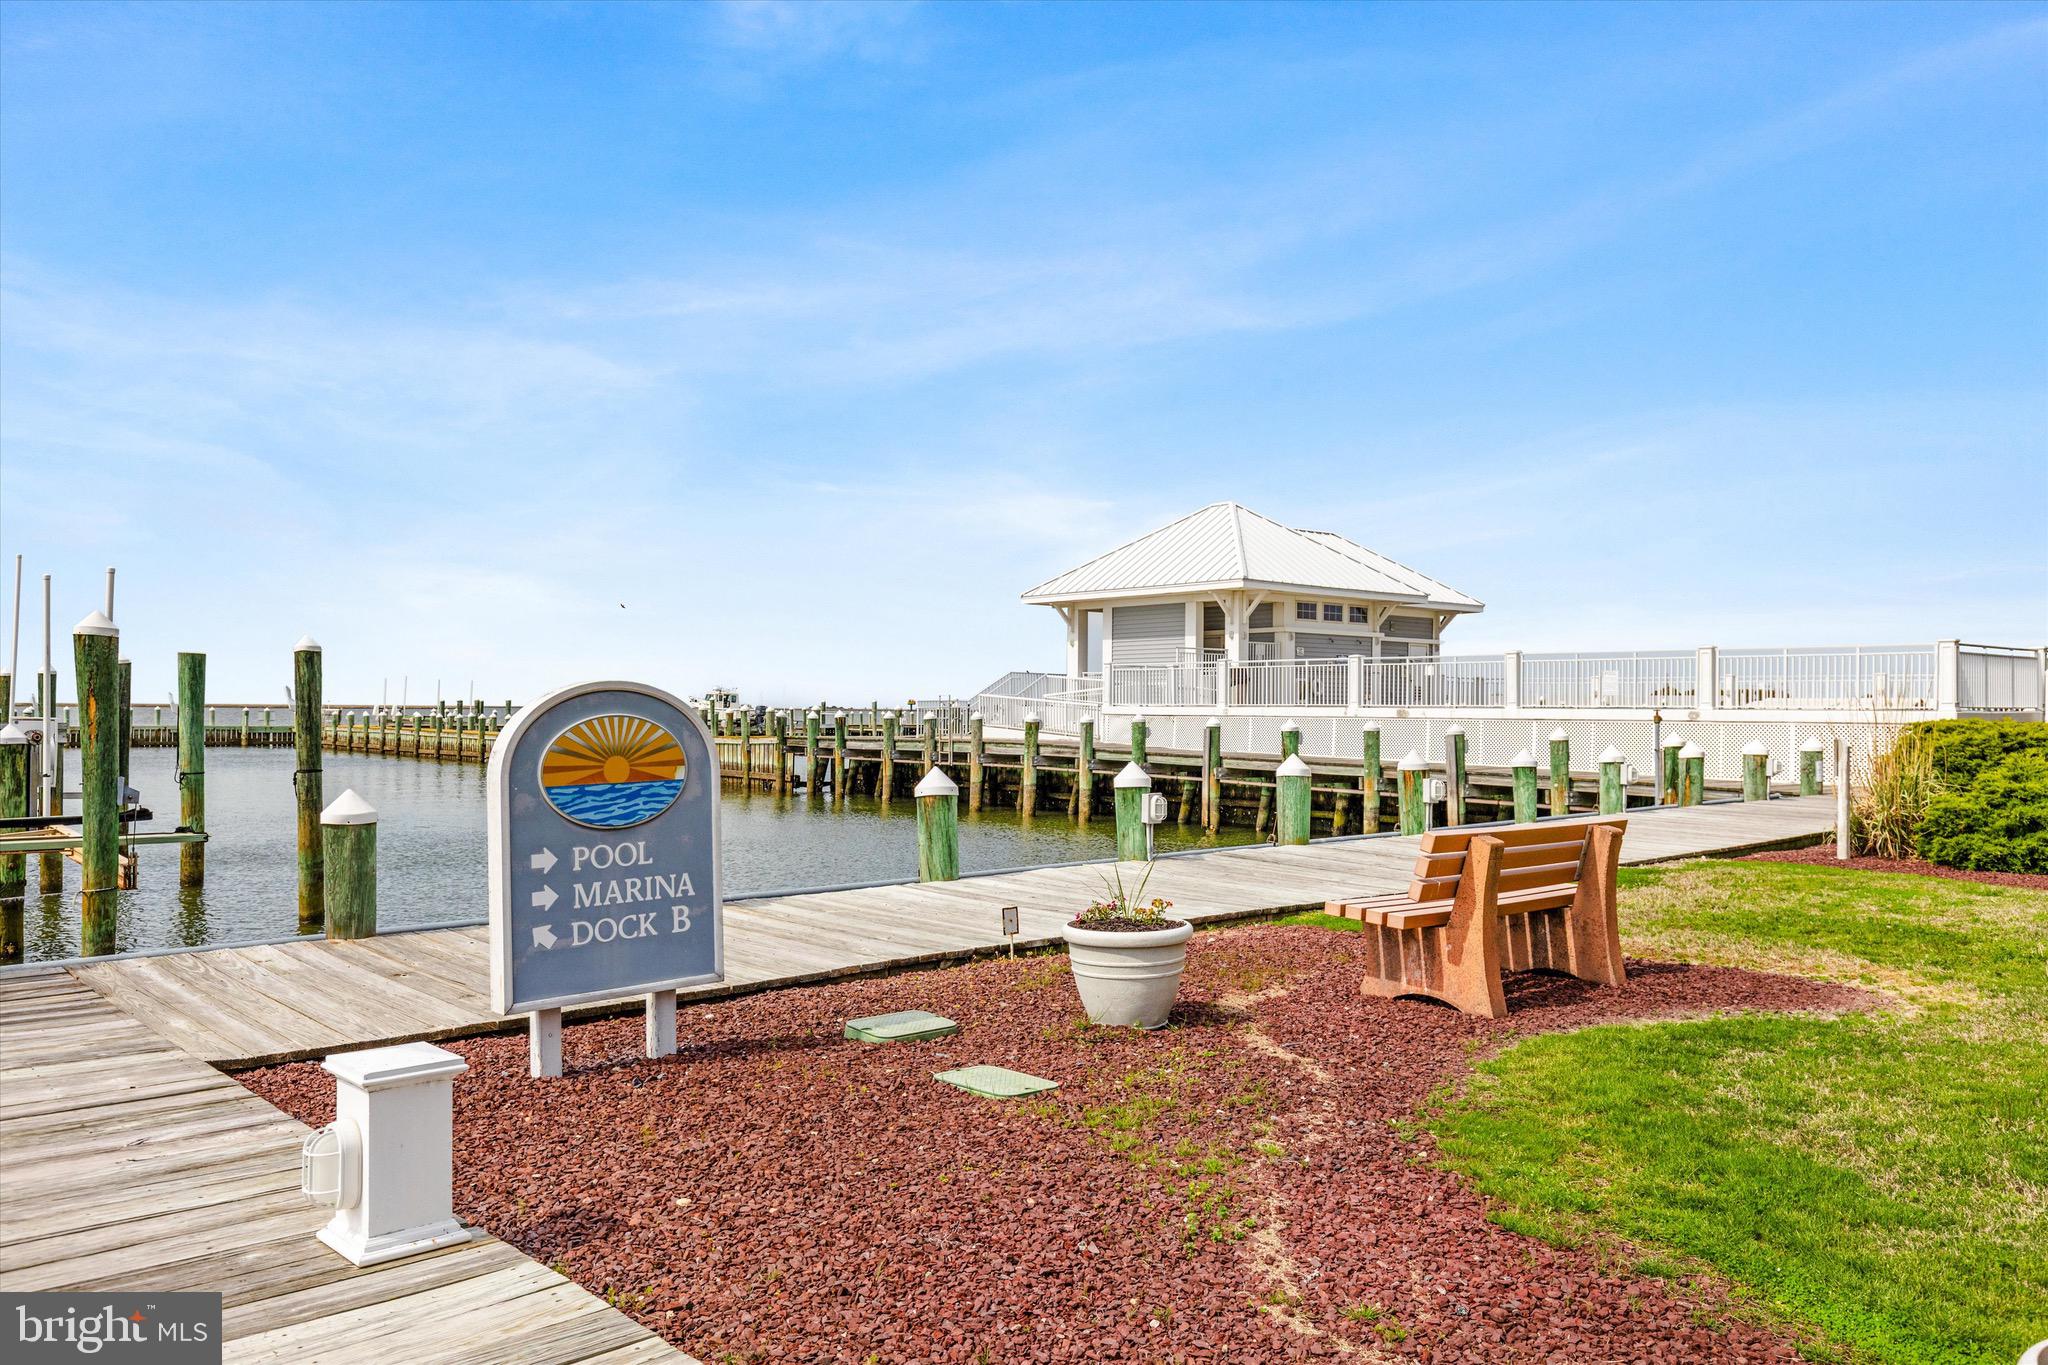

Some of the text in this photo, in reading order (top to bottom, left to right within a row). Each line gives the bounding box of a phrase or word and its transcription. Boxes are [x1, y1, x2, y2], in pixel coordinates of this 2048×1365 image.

[572, 841, 653, 871] POOL
[573, 872, 695, 909] MARINA
[571, 905, 691, 946] DOCK B
